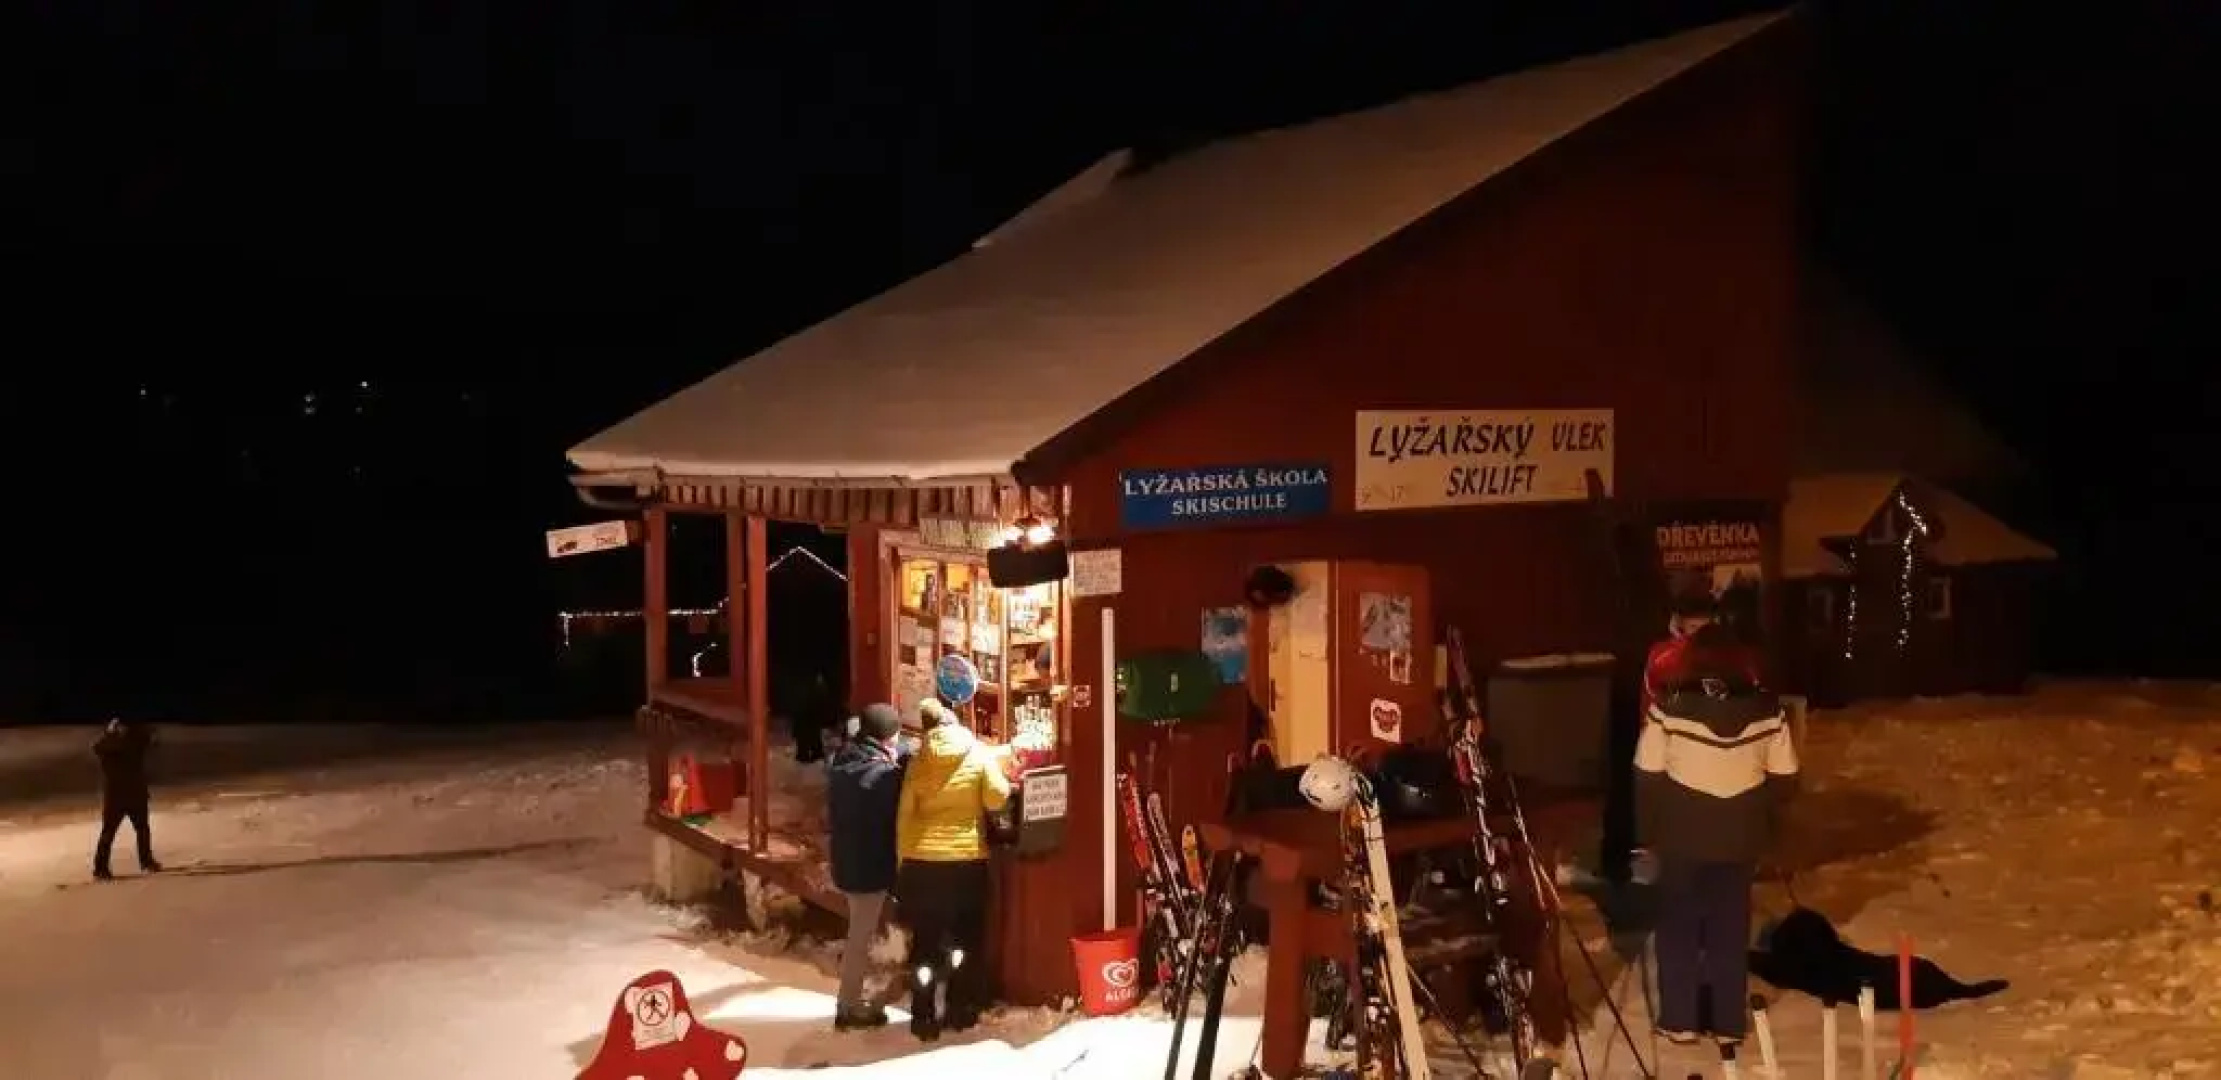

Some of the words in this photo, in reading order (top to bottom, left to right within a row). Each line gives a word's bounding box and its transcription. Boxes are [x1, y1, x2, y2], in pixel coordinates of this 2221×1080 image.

[1369, 416, 1535, 463] LYŽAŘSKÝ
[1124, 468, 1250, 496] LYŽAŘSKÁ
[1254, 467, 1329, 487] ŠKOLA
[1446, 464, 1538, 497] SKILIFT
[1171, 491, 1287, 515] SKISCHULE
